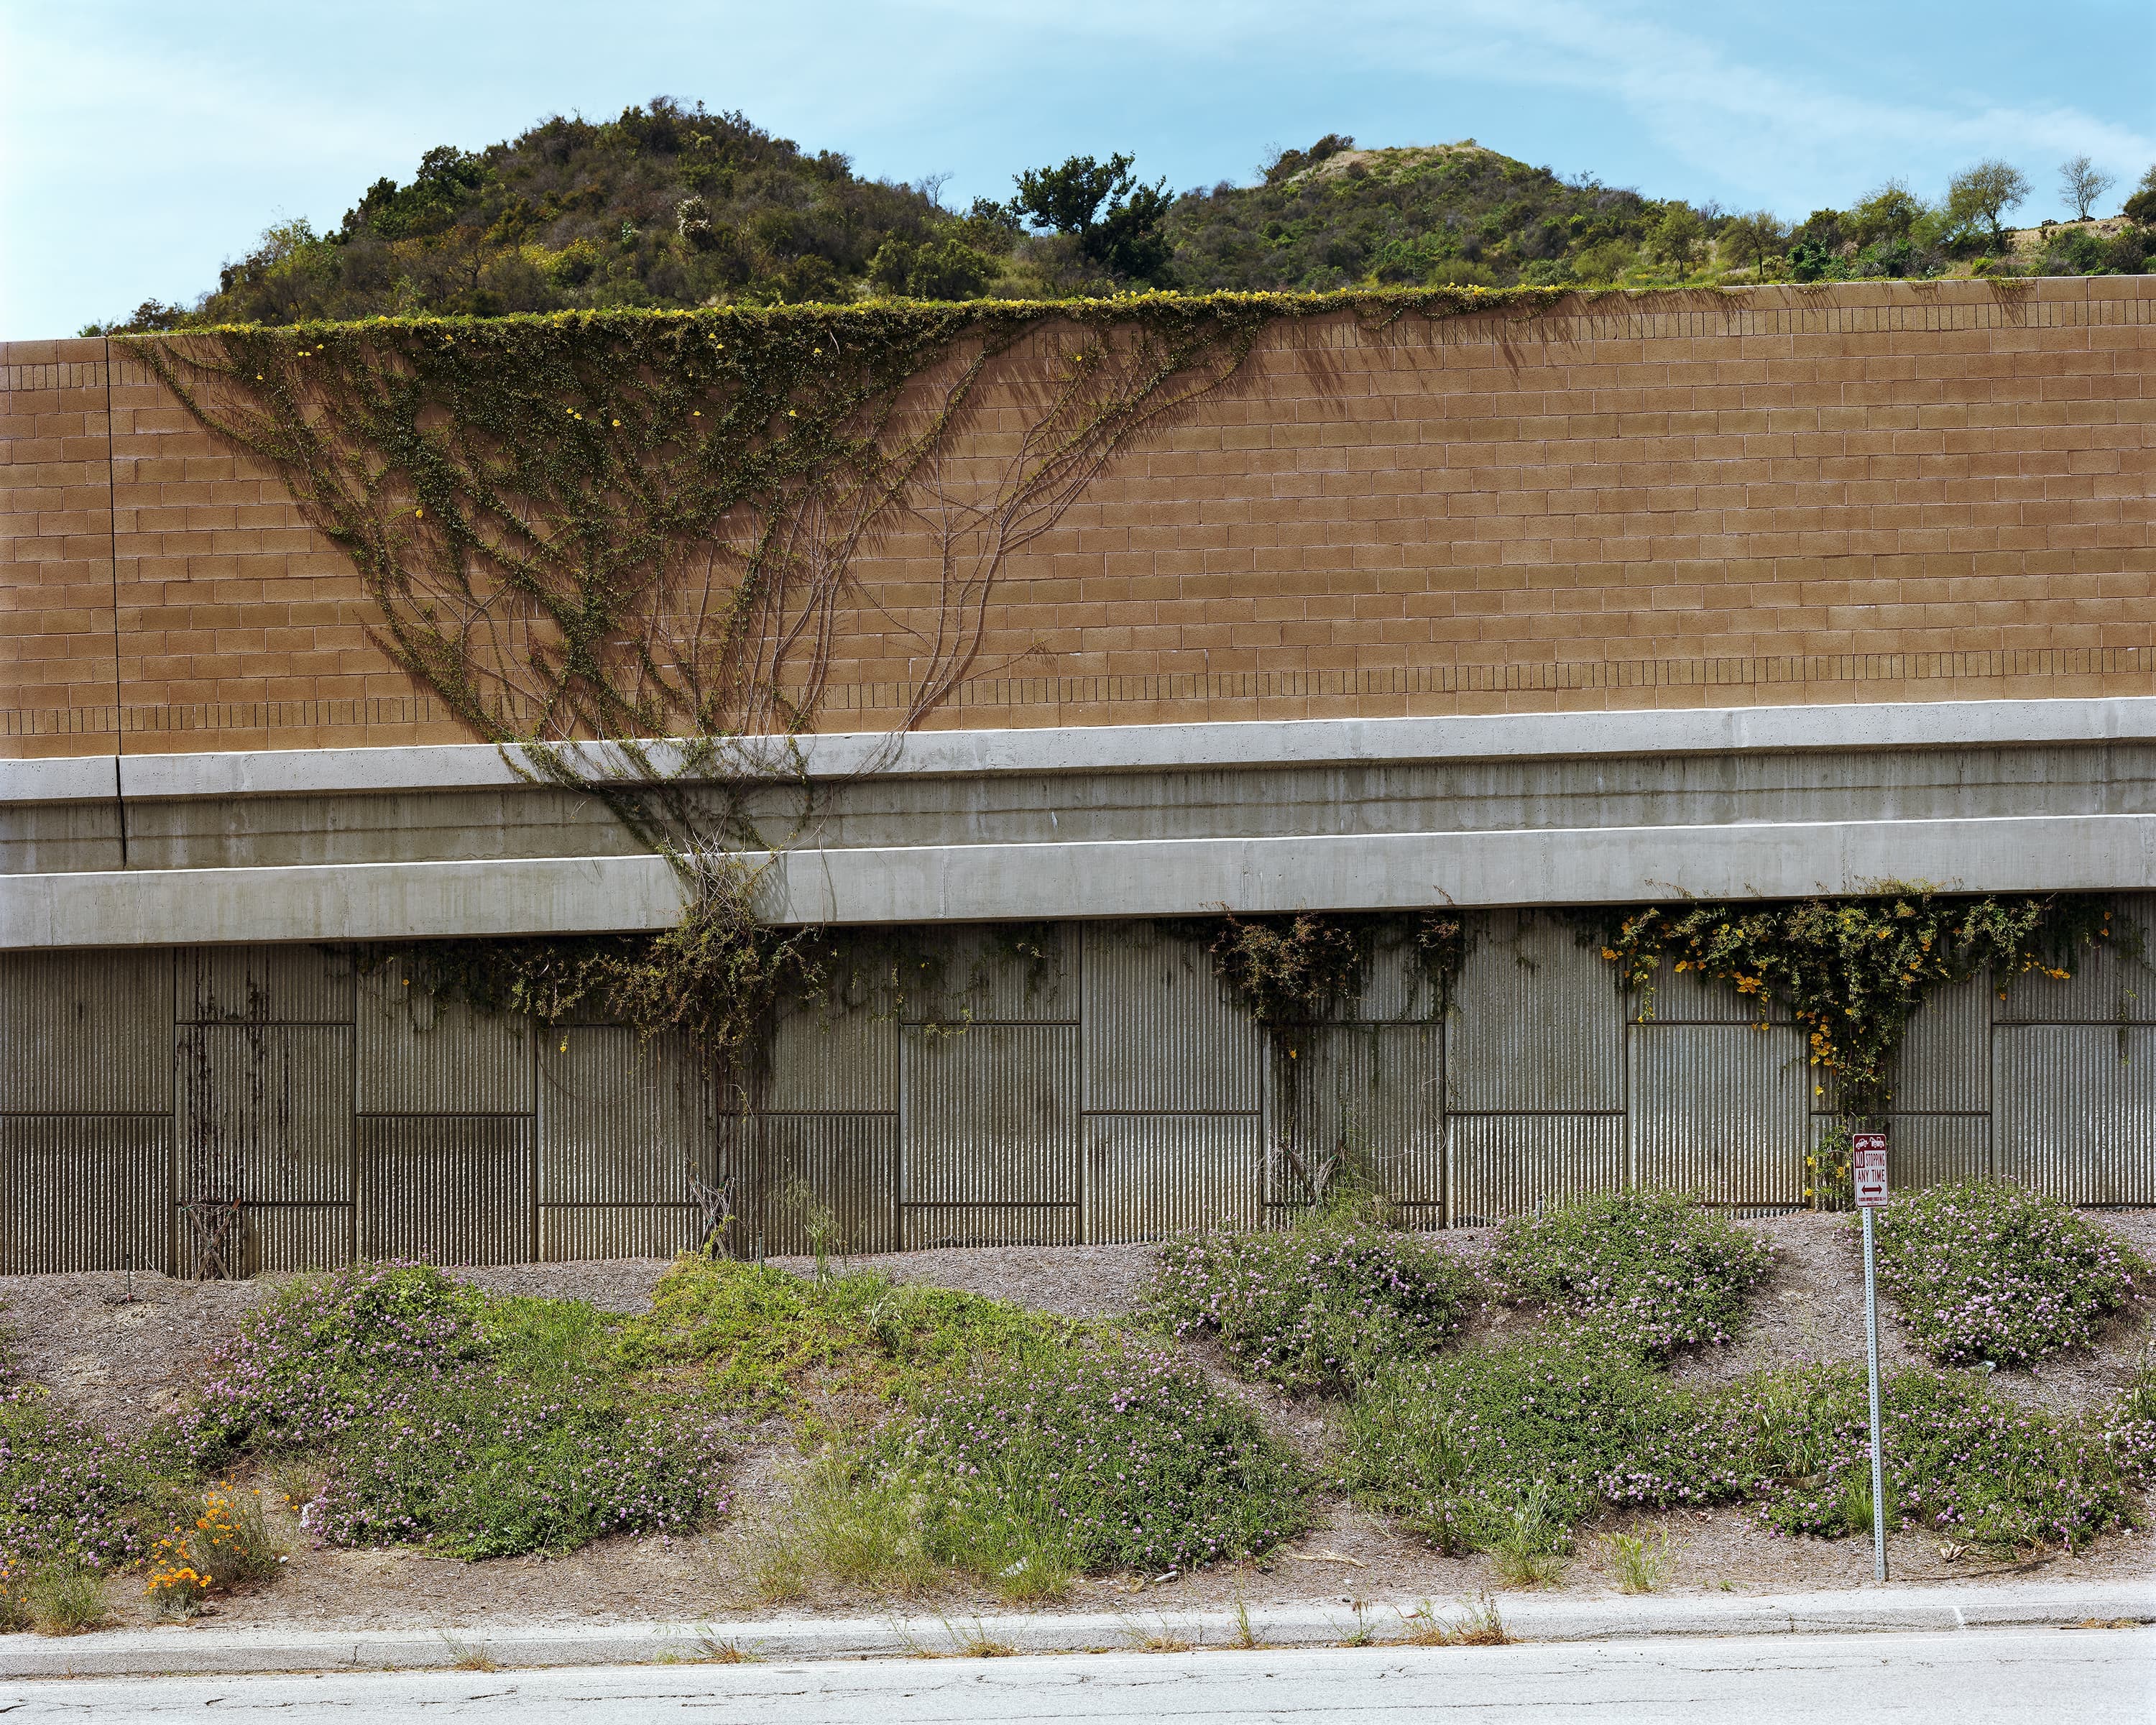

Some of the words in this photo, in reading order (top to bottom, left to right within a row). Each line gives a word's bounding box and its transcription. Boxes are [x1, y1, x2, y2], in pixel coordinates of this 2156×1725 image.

[1856, 1151, 1864, 1167] NO
[1866, 1153, 1885, 1167] STOPPING
[1858, 1170, 1869, 1182] ANY
[1871, 1169, 1885, 1182] TIME
